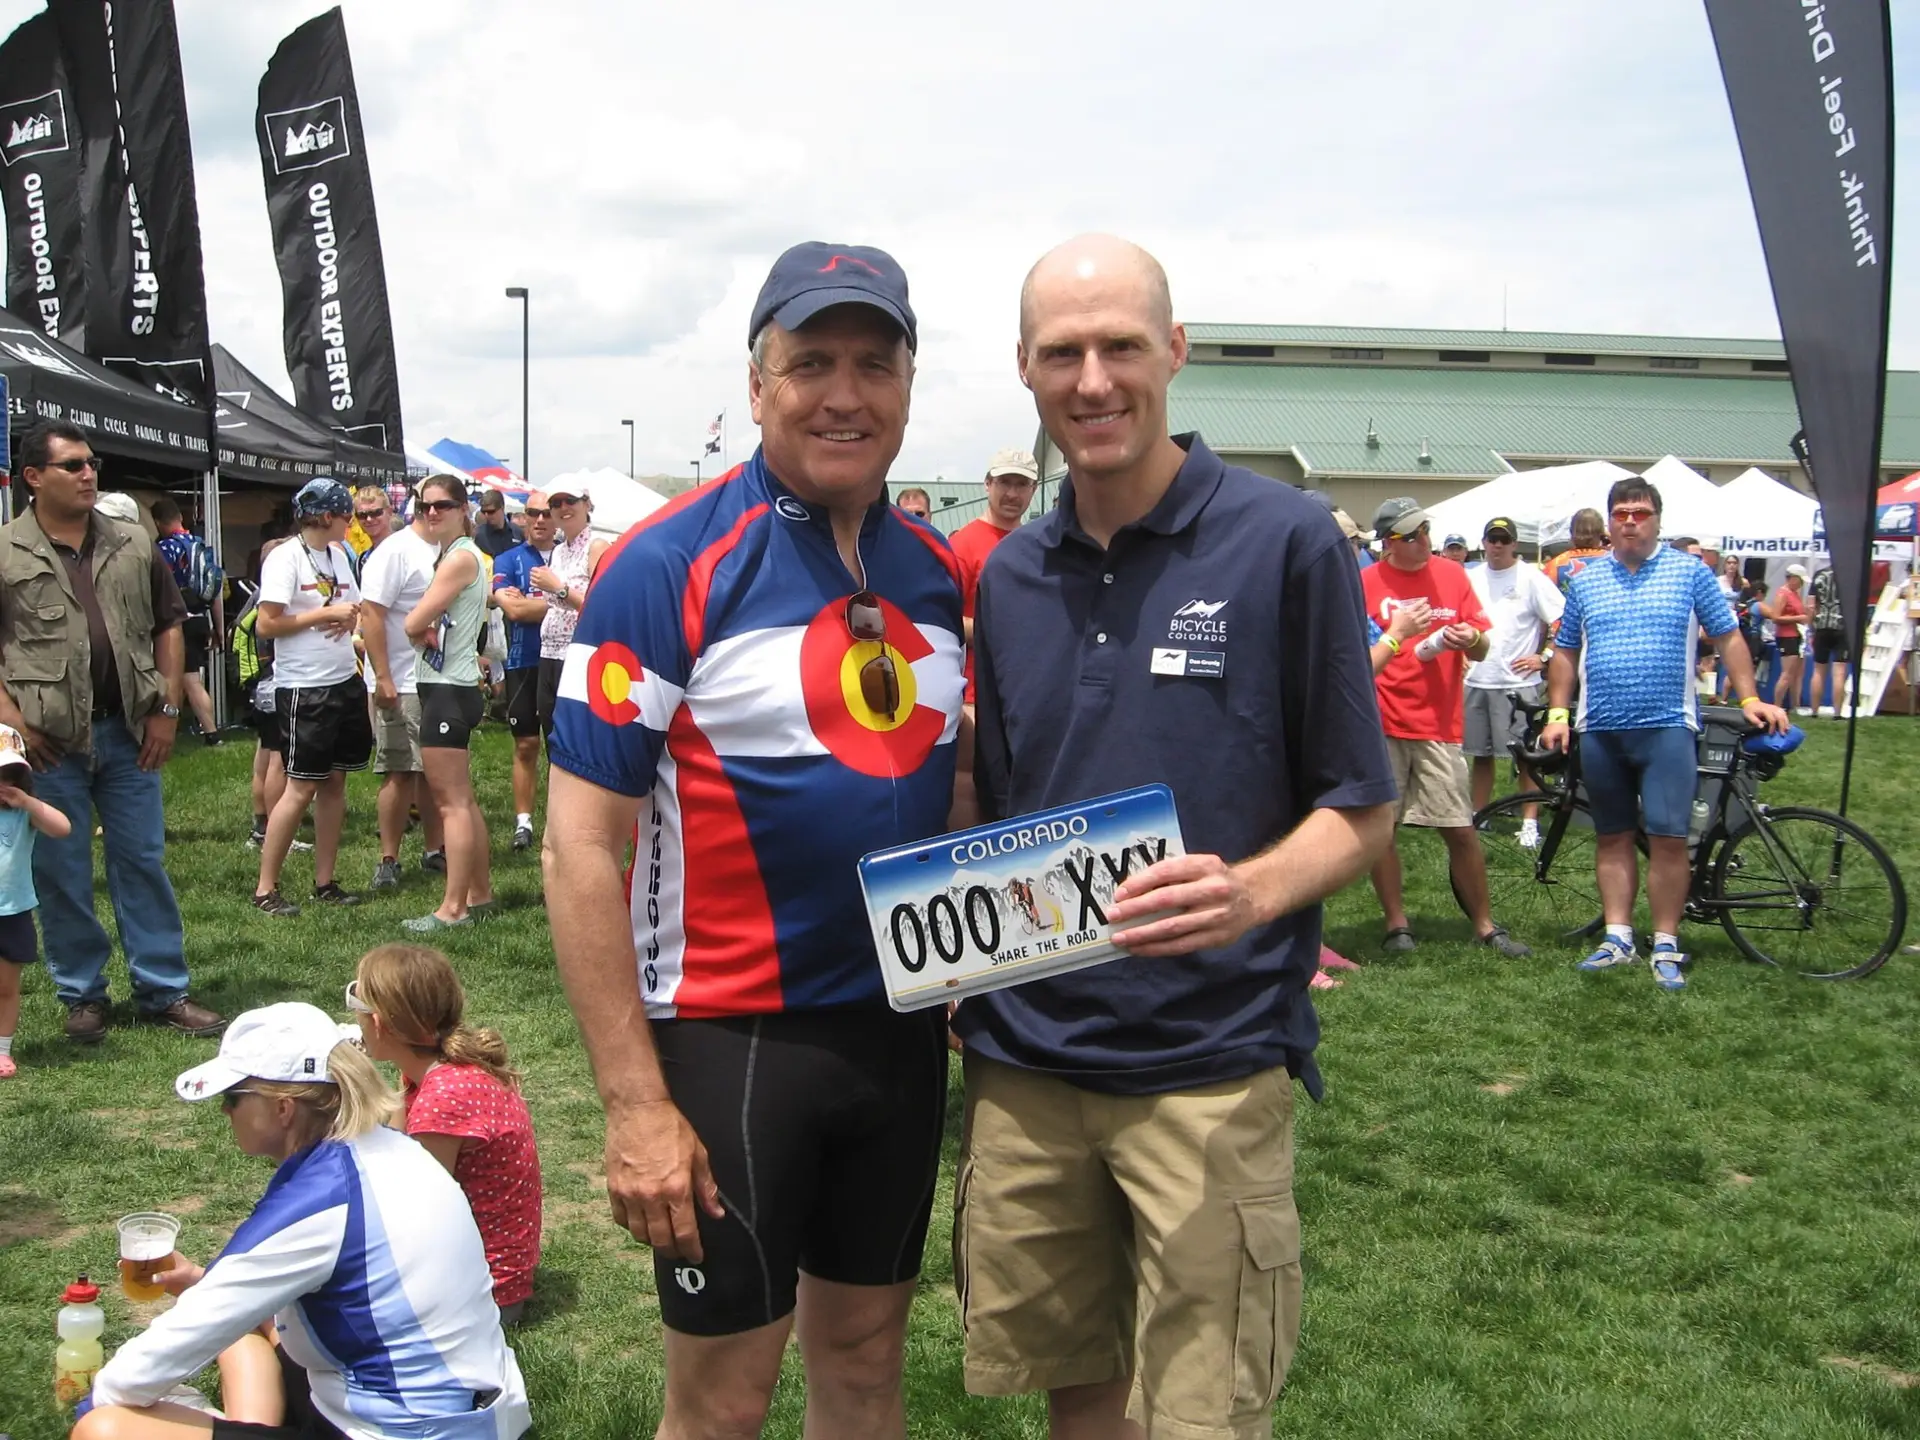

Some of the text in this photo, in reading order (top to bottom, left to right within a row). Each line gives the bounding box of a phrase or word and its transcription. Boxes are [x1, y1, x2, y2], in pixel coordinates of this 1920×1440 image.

[24, 172, 56, 294] OUTDOOR
[308, 181, 354, 411] OUTDOOR EXPERTS
[36, 399, 62, 419] CAMP
[70, 408, 97, 428] CLIMB
[104, 416, 129, 436] CYCLE
[135, 424, 164, 443] PADDLE
[168, 432, 181, 448] SKI
[184, 435, 210, 453] TRAVEL
[1168, 632, 1227, 643] COLORADO
[1170, 619, 1227, 633] BICYCLE
[950, 815, 1088, 865] COLORADO
[890, 885, 1001, 973] 000
[990, 928, 1098, 966] SHARE THE ROAD
